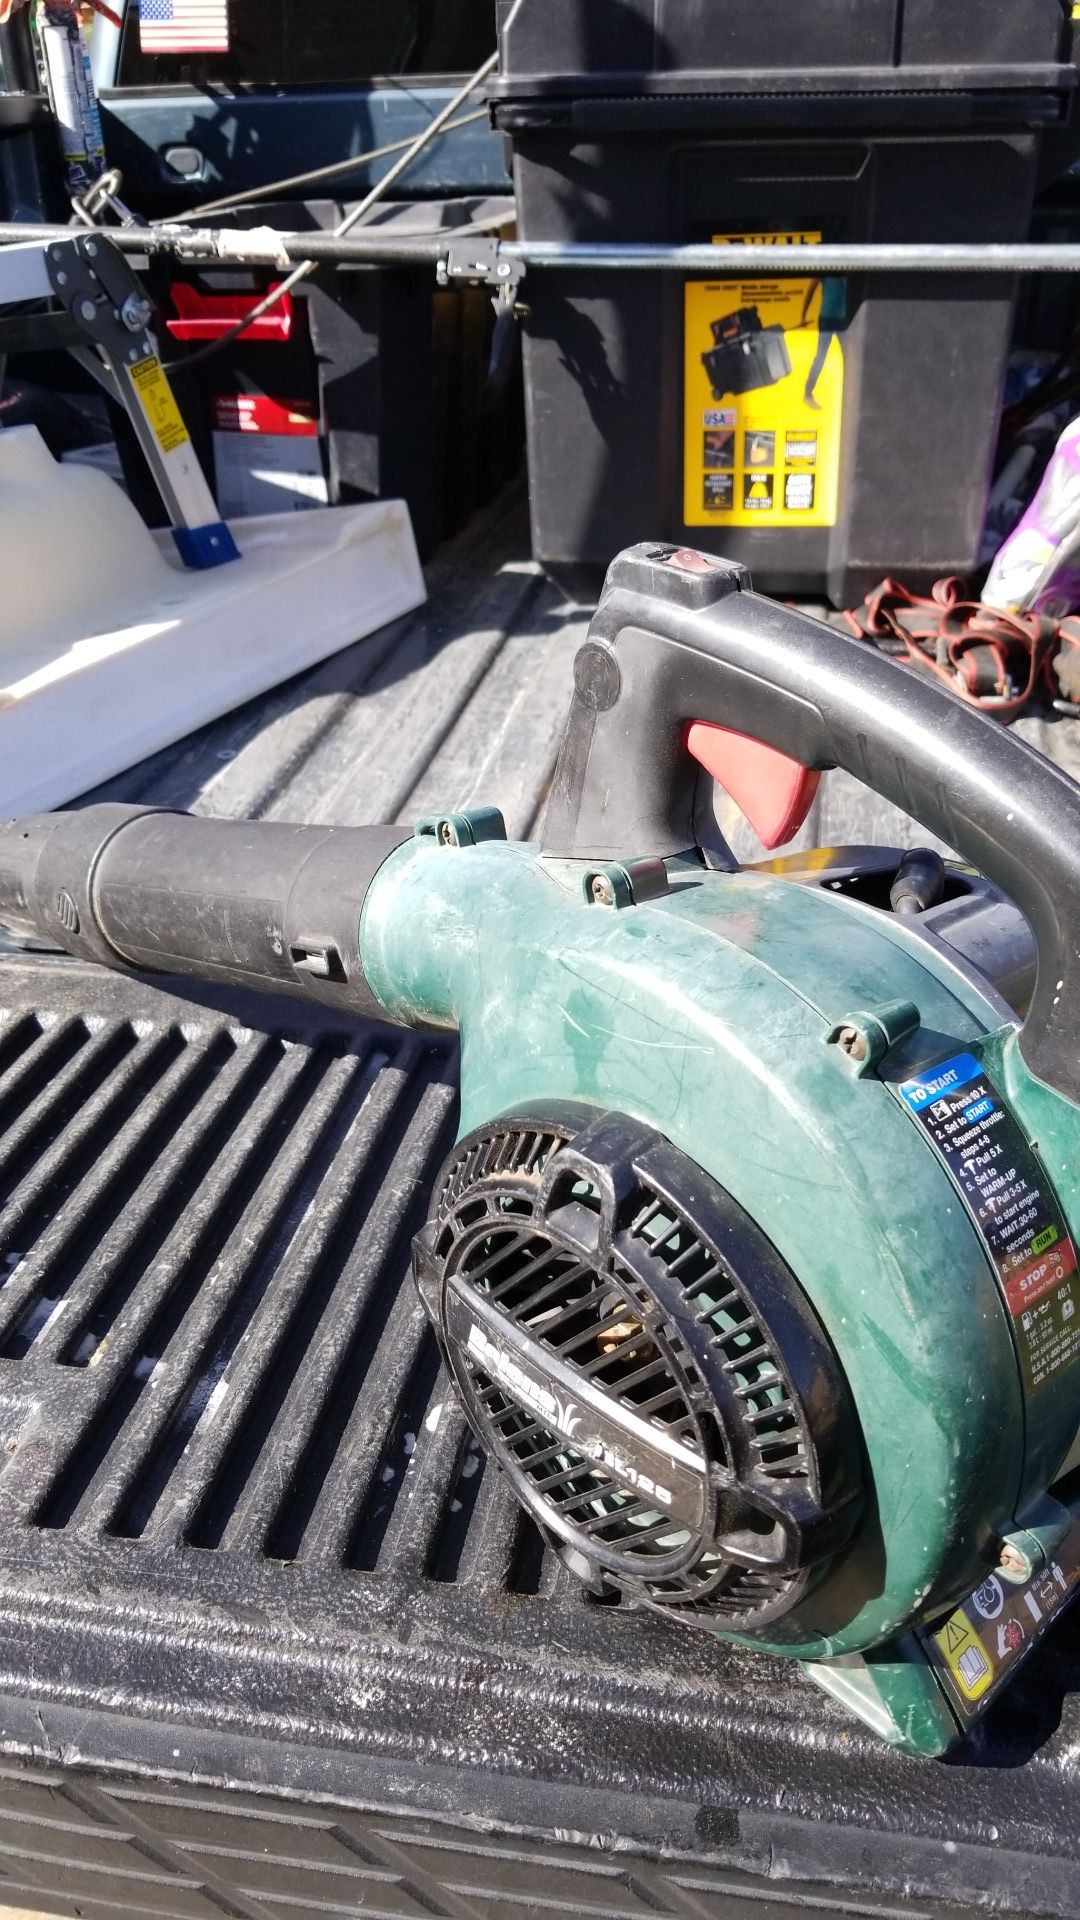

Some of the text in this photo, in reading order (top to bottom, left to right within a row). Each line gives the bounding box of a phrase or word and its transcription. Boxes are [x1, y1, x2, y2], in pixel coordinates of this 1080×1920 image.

[908, 1069, 959, 1103] TO START
[927, 1085, 987, 1126] 1. Press 10 X
[935, 1100, 990, 1140] 2. Set to START
[943, 1110, 1005, 1152] 3. Squeeze throttle:
[960, 1134, 991, 1159] steps 4-8
[959, 1143, 1003, 1177] 4. Pull 5 X
[965, 1167, 997, 1192] 5. Set to
[980, 1168, 1017, 1198] WARM-UP
[979, 1178, 1028, 1218] 6. Pull 3-5 X
[994, 1189, 1040, 1226] to start engine
[990, 1207, 1038, 1246] 7. WAIT 30-60
[1006, 1228, 1035, 1253] seconds
[1001, 1230, 1052, 1274] 8. Set to RUN
[1019, 1264, 1047, 1291] STOP
[1057, 1282, 1071, 1300] 40:1
[1030, 1350, 1040, 1362] FOR
